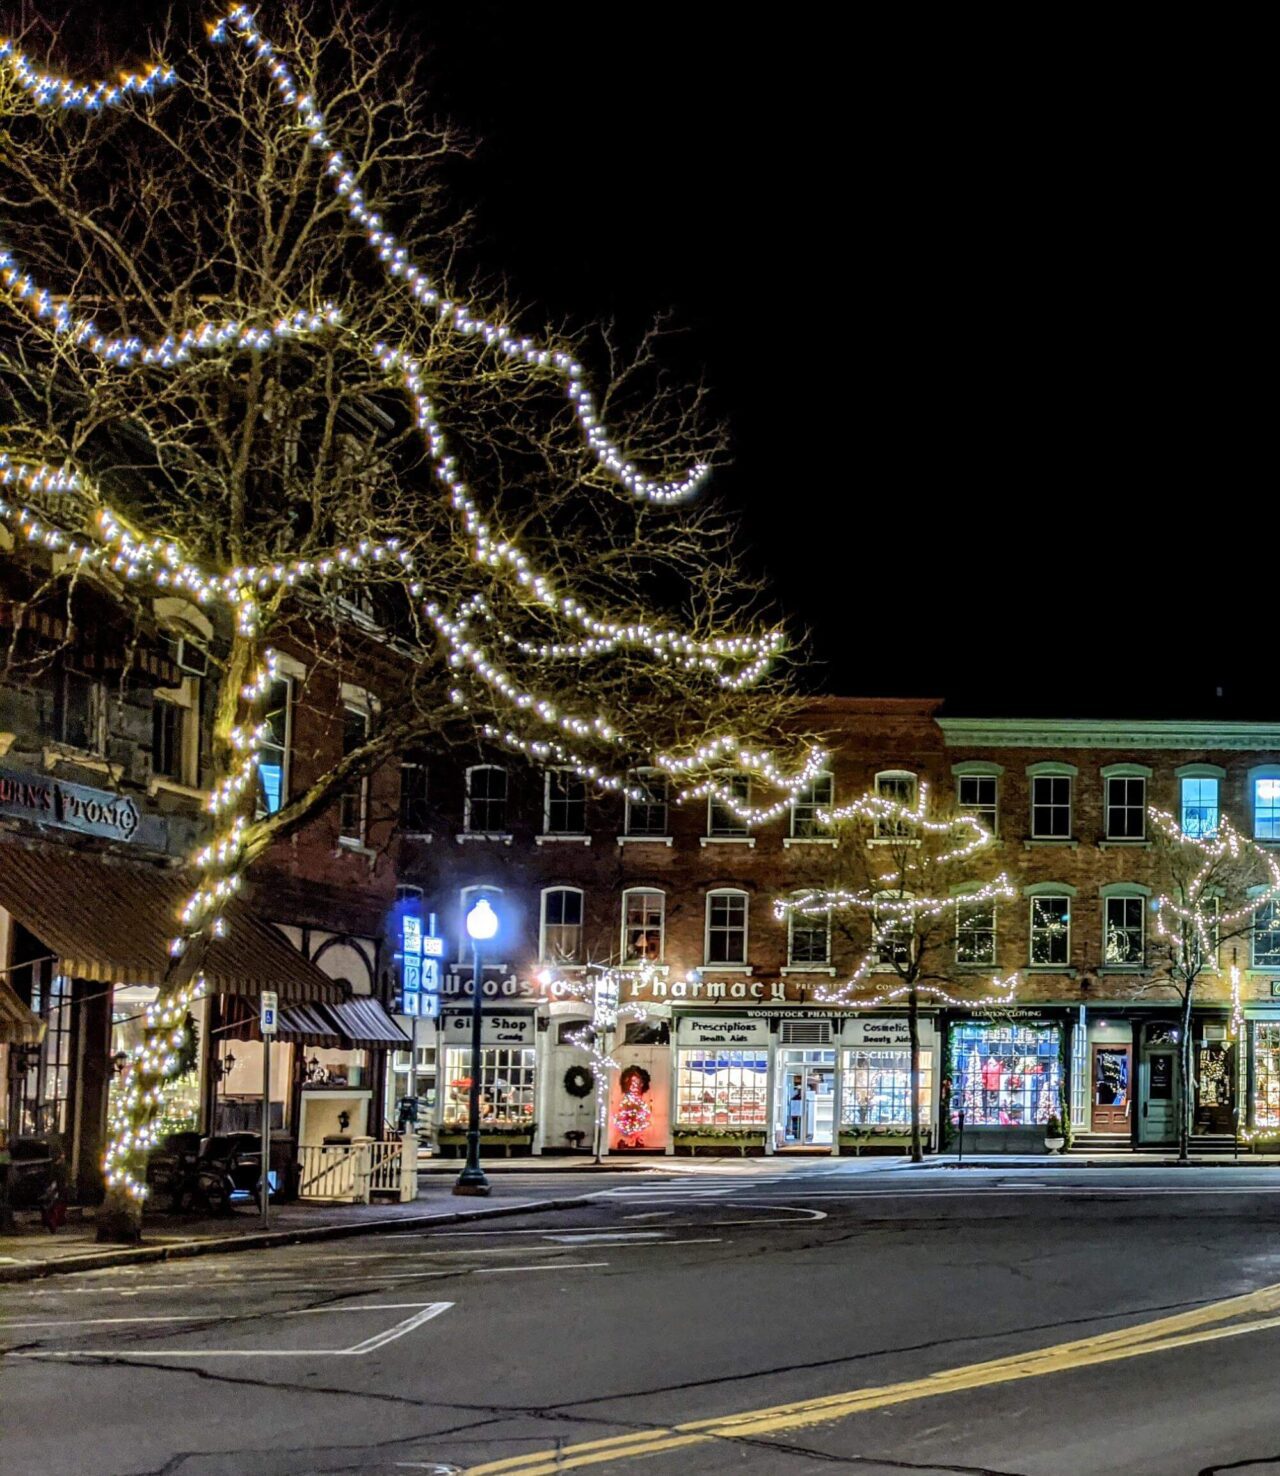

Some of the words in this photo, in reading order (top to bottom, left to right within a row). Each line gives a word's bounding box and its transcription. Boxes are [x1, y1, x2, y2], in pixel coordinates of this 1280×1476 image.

[407, 968, 417, 988] 12
[426, 965, 432, 984] 4
[630, 975, 786, 1001] Pharmacy
[747, 1010, 805, 1018] WOODSTOCK
[807, 1010, 861, 1018] PHARMACY
[1007, 1010, 1042, 1018] CLOTHING
[492, 1018, 527, 1030] Shop
[691, 1022, 757, 1033] Prescriptions
[863, 1022, 910, 1032] Cosmetic
[497, 1033, 523, 1041] Candy
[700, 1034, 726, 1042] Health
[730, 1034, 748, 1042] Aids
[863, 1035, 892, 1044] Beauty
